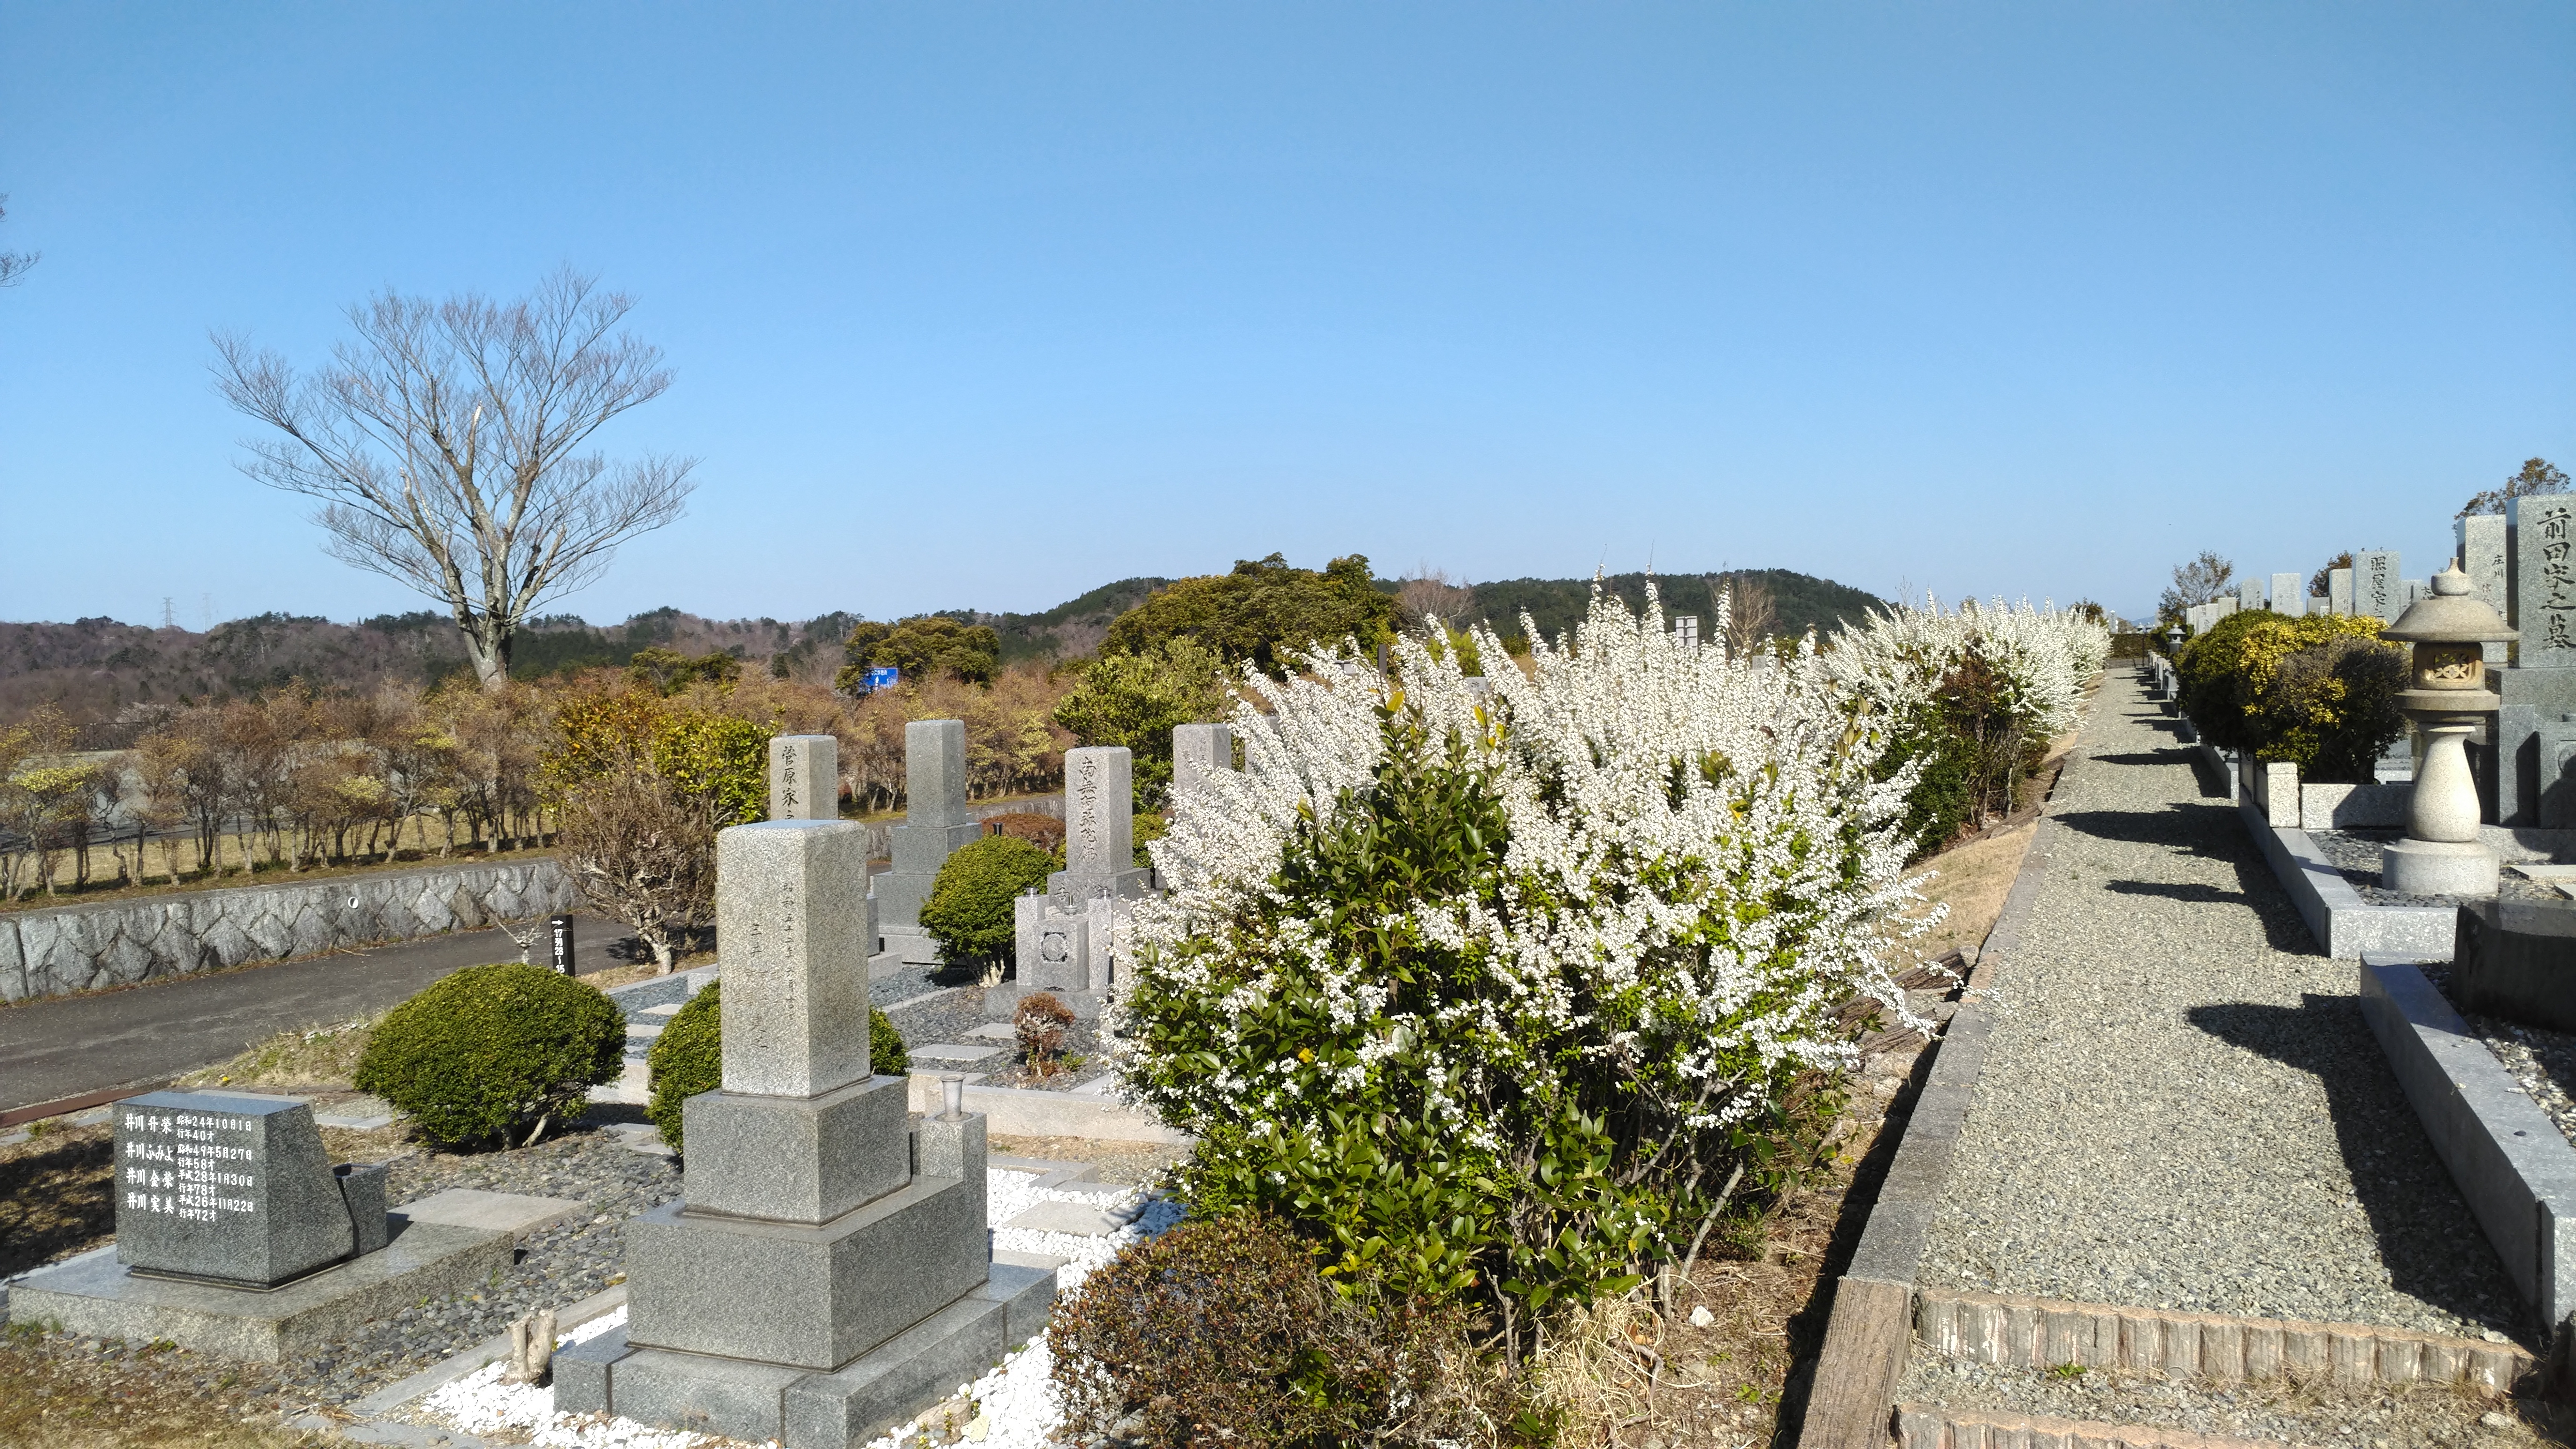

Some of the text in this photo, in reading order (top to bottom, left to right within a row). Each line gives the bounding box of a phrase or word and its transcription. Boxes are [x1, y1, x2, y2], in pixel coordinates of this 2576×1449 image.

[2537, 507, 2576, 648] 前田家之墓
[176, 1115, 251, 1131] 昭和24年10月1日
[177, 1144, 252, 1160] 昭和49年5月27日
[177, 1169, 253, 1187] 平成28年1月30日
[178, 1195, 253, 1212] 平成26年11月22日
